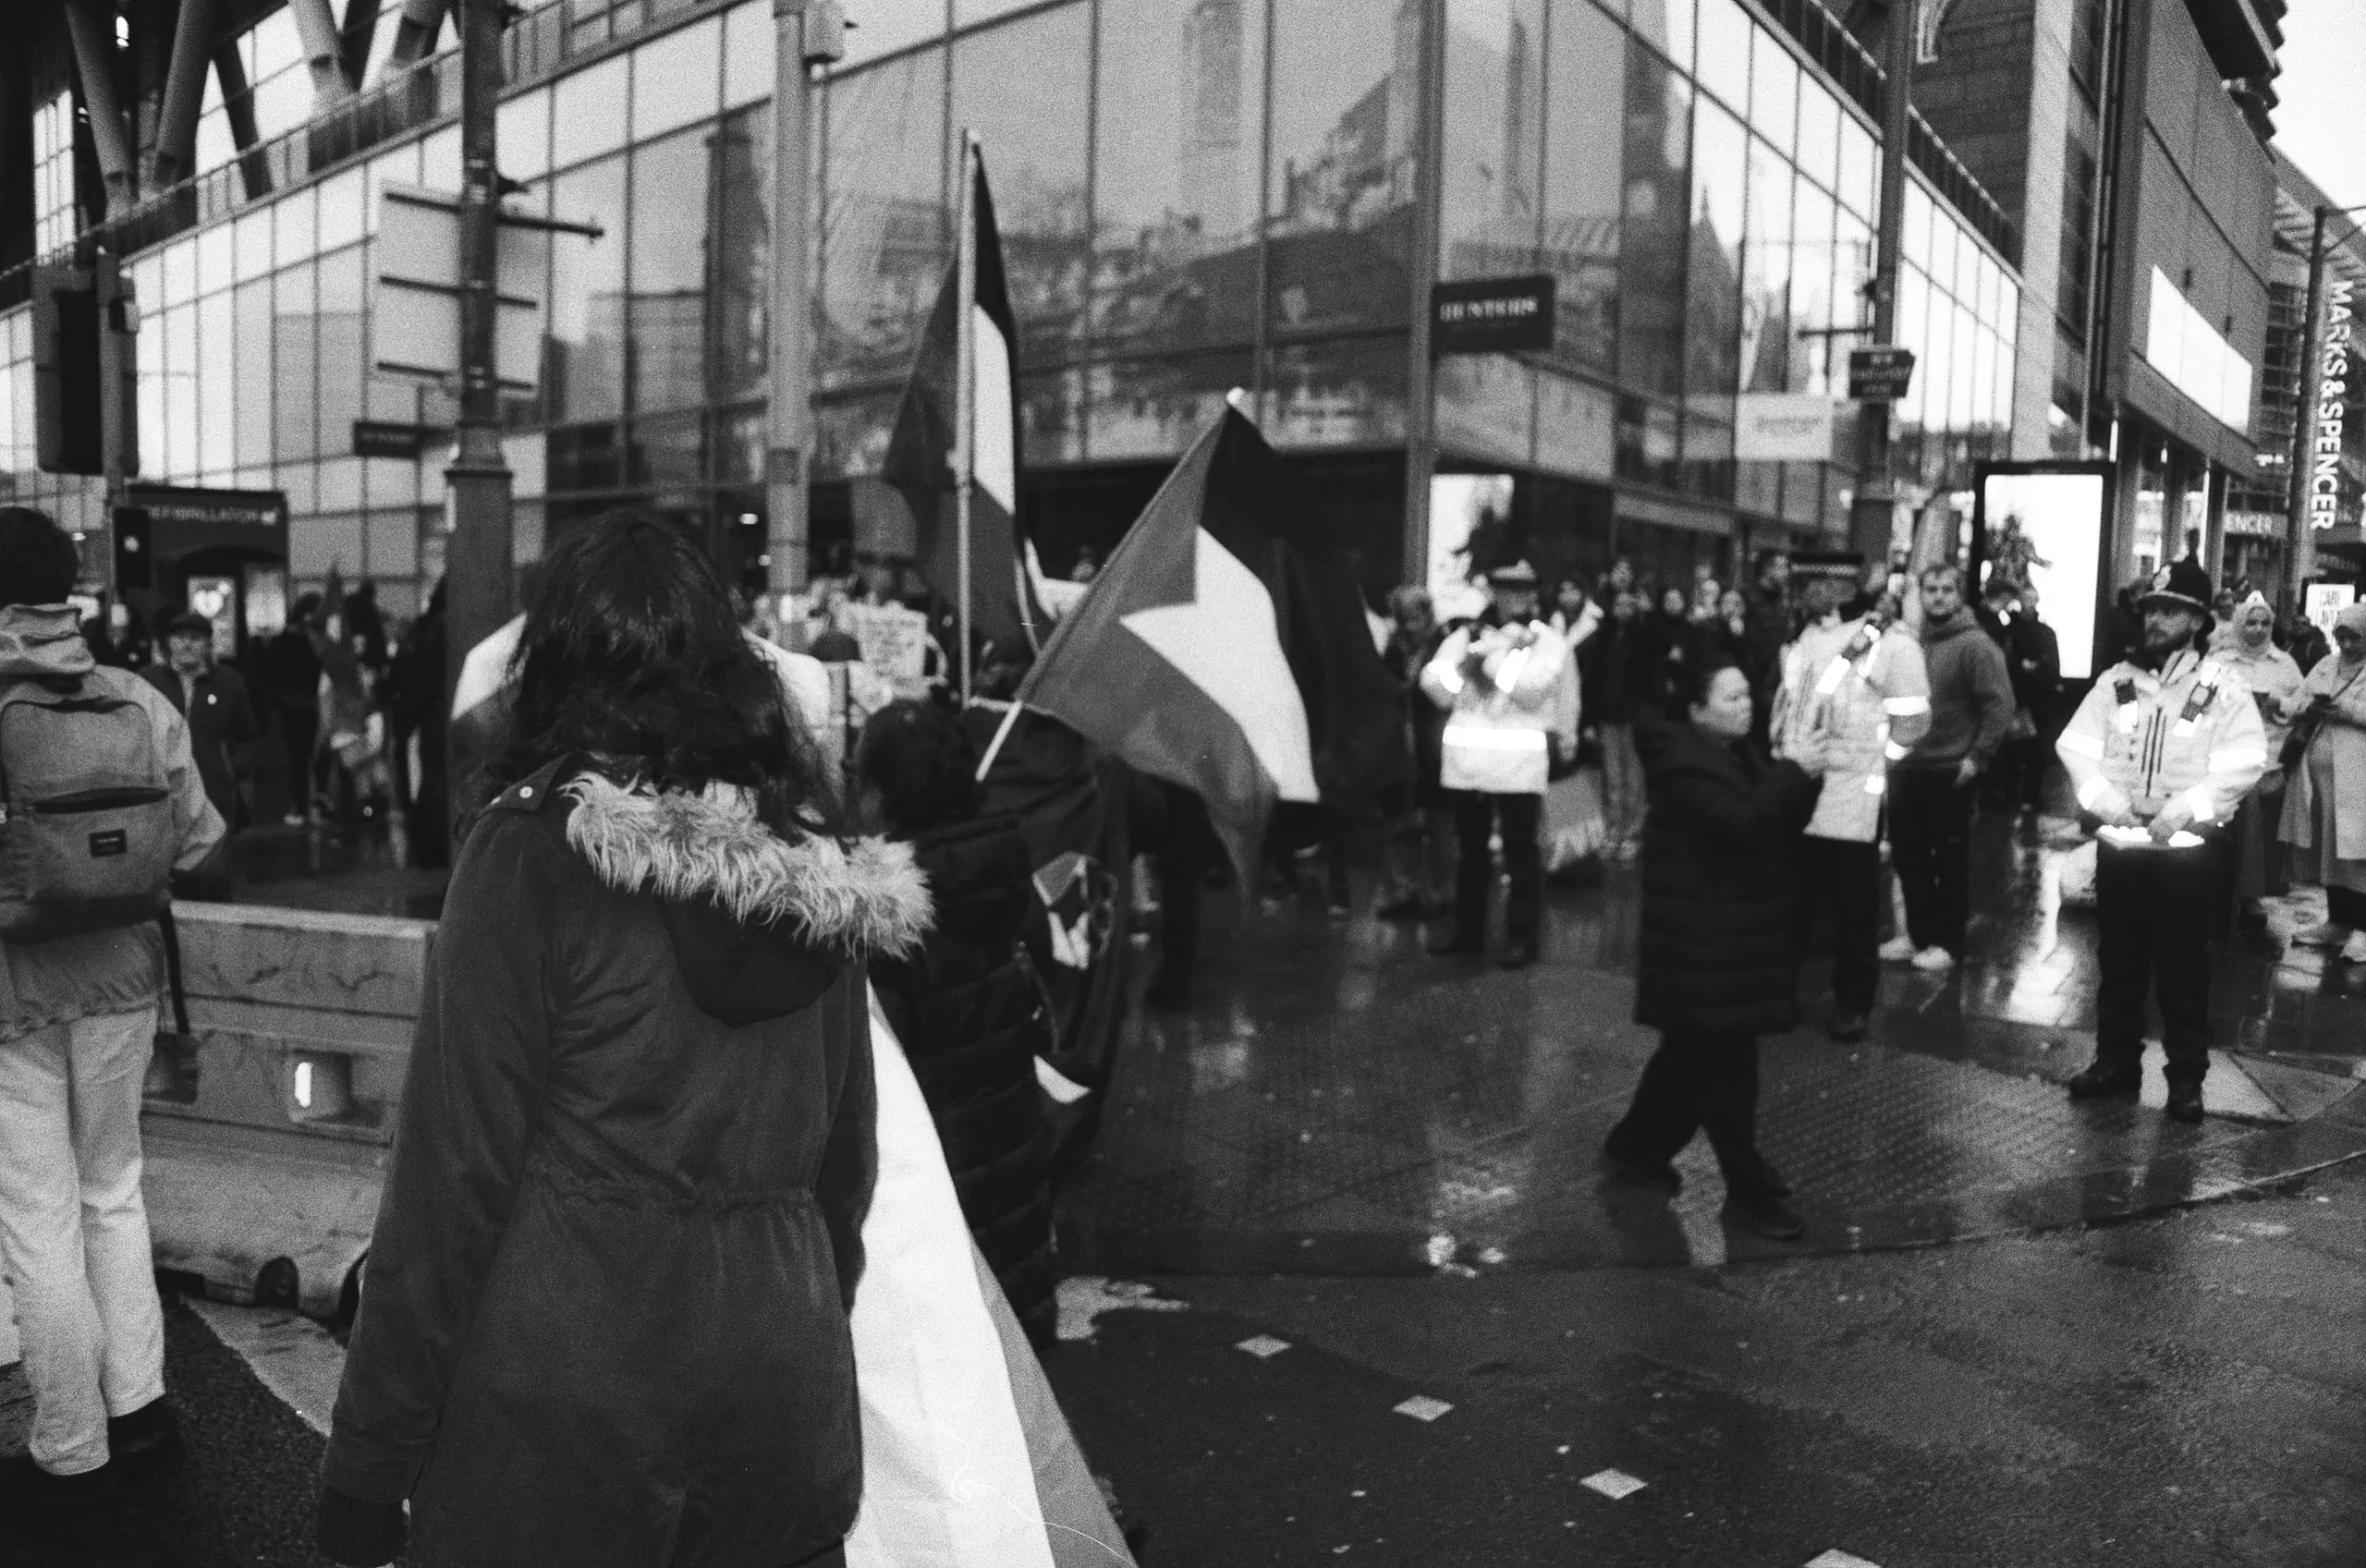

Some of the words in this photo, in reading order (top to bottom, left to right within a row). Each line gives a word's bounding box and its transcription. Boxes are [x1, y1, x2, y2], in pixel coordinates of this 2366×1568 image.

[2323, 280, 2355, 377] MARKS
[2320, 380, 2346, 398] &
[2310, 401, 2344, 530] SPENCER
